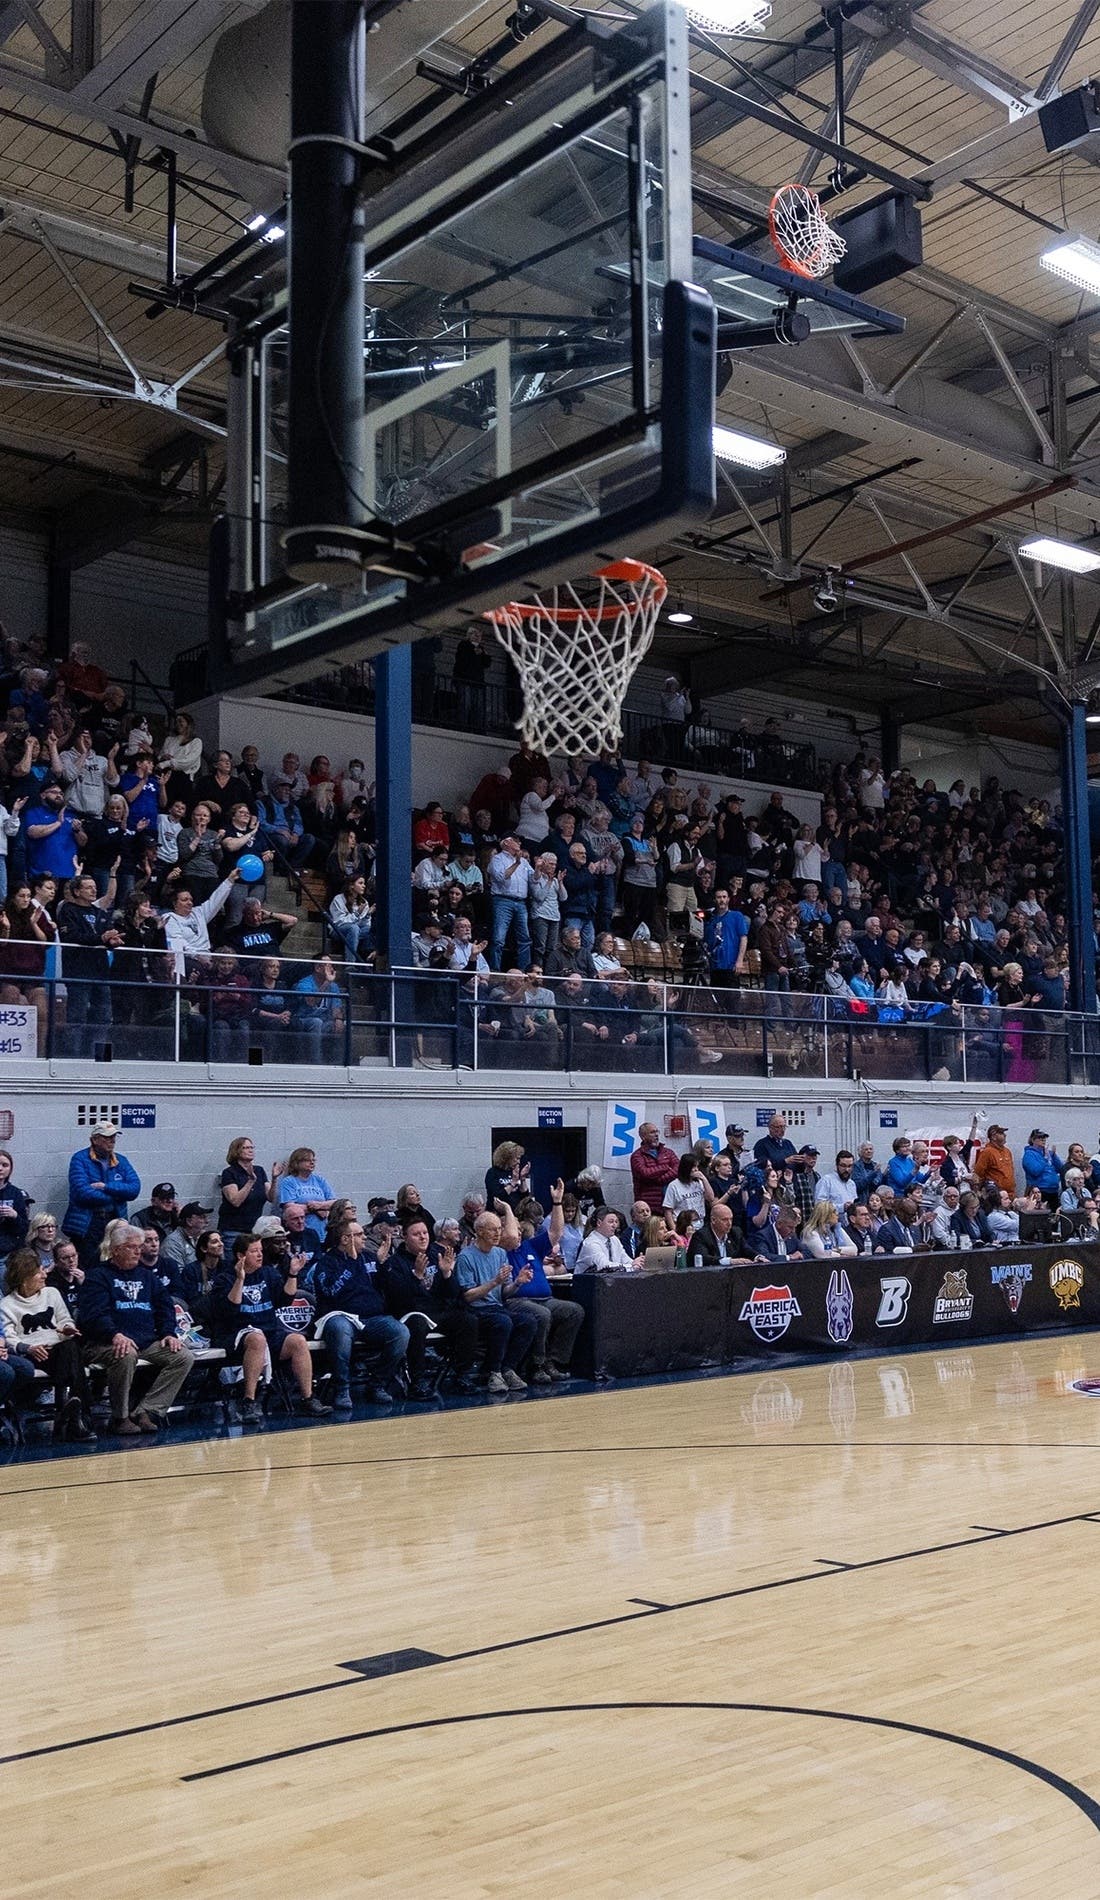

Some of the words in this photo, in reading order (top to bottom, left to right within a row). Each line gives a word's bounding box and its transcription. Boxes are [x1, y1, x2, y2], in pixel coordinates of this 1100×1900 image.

[122, 1108, 155, 1116] SECTION
[132, 1117, 146, 1125] 102
[990, 1263, 1033, 1284] MAINE
[1050, 1261, 1082, 1287] UMBC
[742, 1299, 799, 1319] AMERICA
[876, 1277, 912, 1328] B
[936, 1297, 972, 1313] BRYANT
[275, 1306, 316, 1318] AMERICA
[283, 1314, 309, 1323] EAST
[755, 1312, 787, 1326] EAST
[935, 1310, 971, 1321] BULLDOGS
